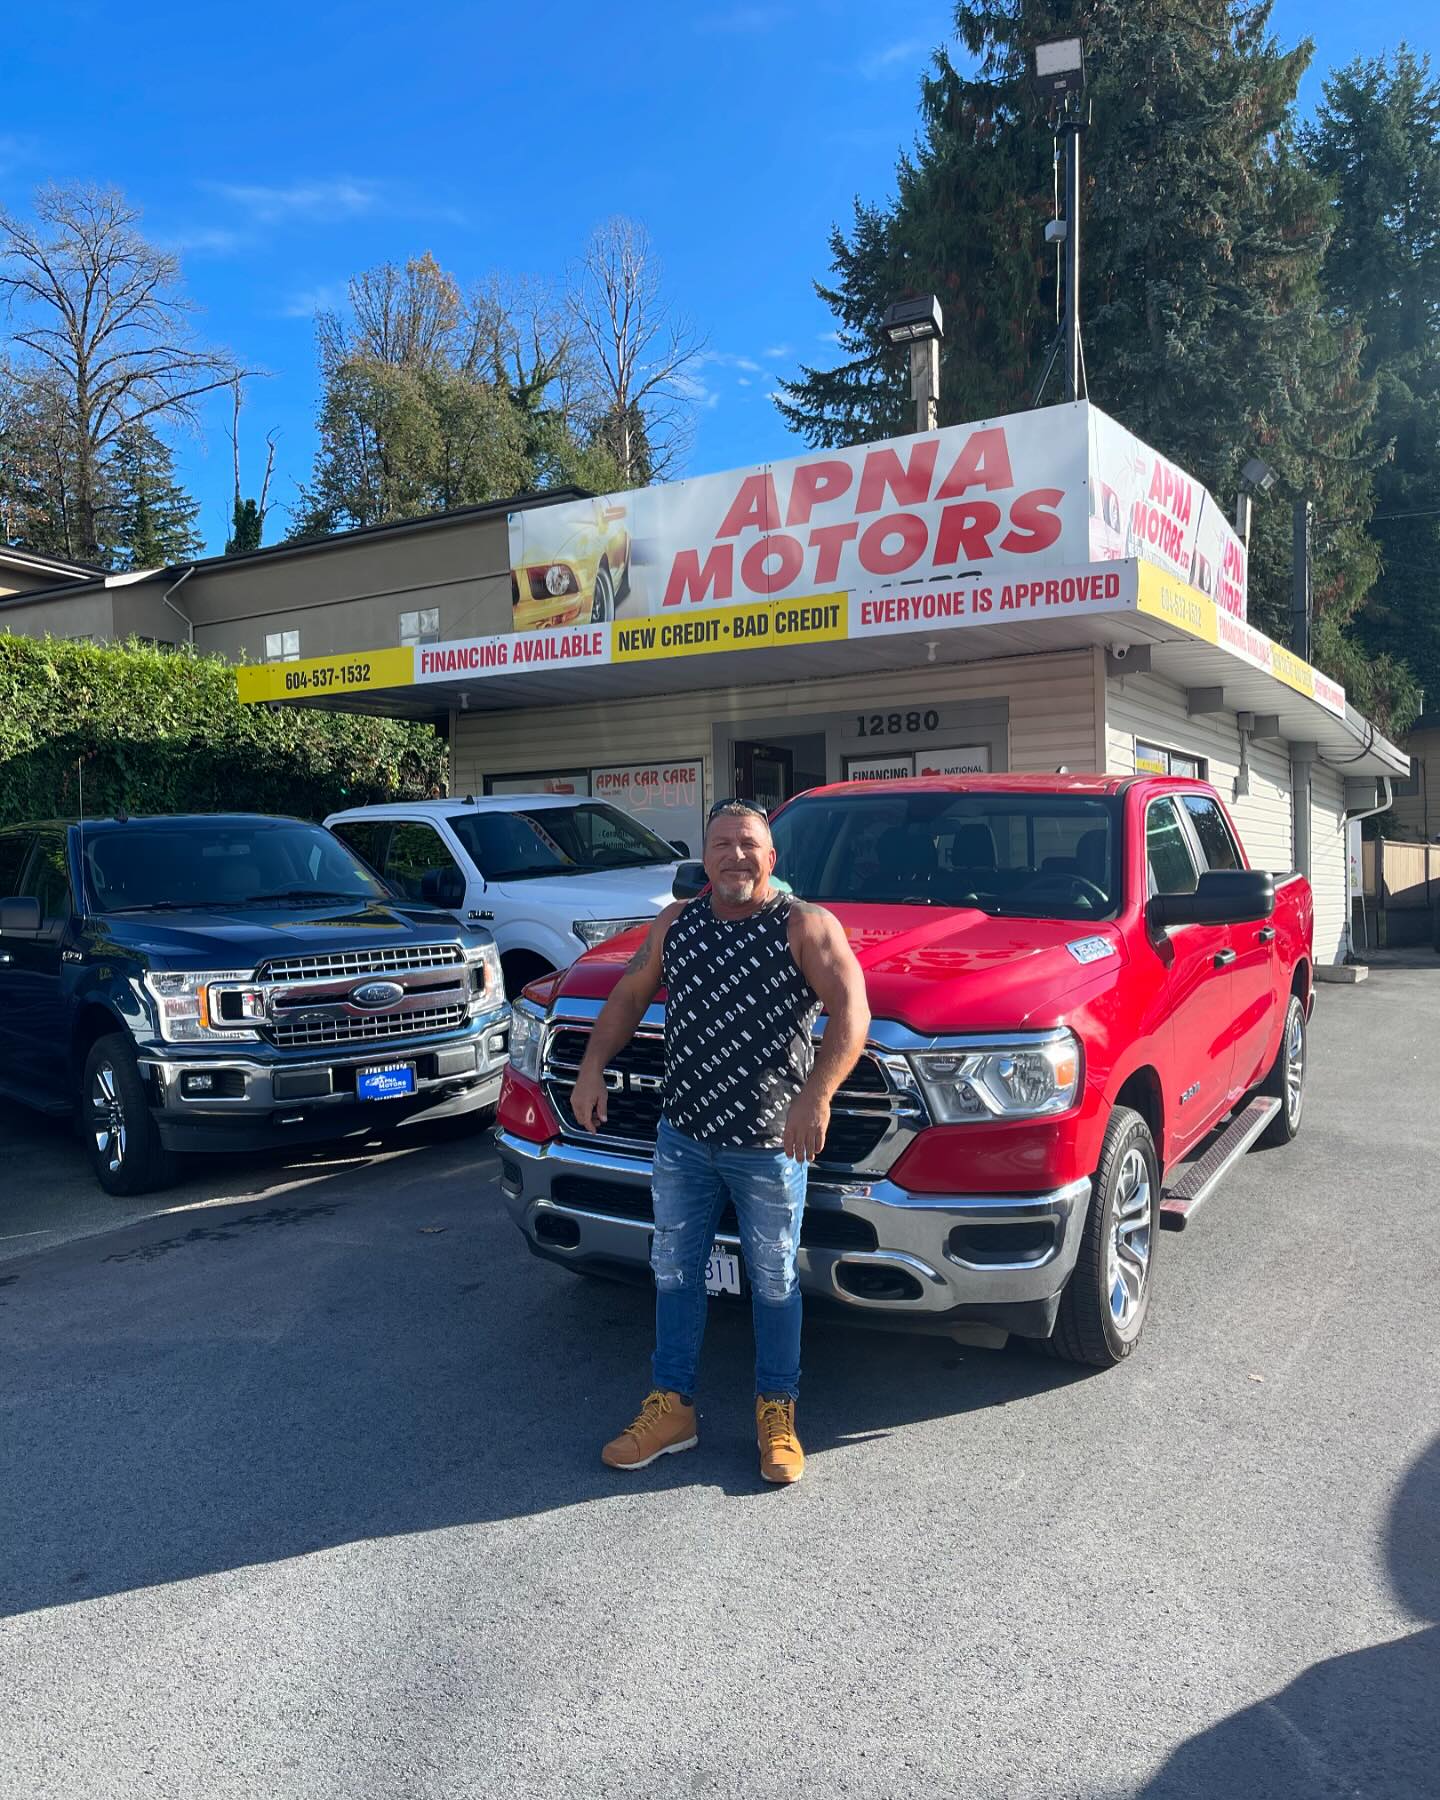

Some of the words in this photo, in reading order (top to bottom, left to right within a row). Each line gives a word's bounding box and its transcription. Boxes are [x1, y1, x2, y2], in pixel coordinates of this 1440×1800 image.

[715, 426, 1014, 540] APNA
[1149, 460, 1192, 527] APNA
[662, 488, 1066, 607] MOTORS
[1132, 501, 1184, 564] MOTORS
[861, 591, 965, 625] EVERYONE
[972, 588, 993, 613] IS
[1000, 573, 1120, 610] APPROVED
[618, 627, 656, 651] NEW
[661, 620, 721, 647] CREDIT
[733, 613, 769, 638] BAD
[775, 605, 840, 633] CREDIT
[421, 643, 508, 674] FINANCING
[513, 632, 603, 663] AVAILABLE
[285, 664, 371, 690] 604-537-1532
[857, 710, 940, 737] 12880
[596, 772, 630, 789] APNA
[634, 770, 659, 786] CAR
[663, 767, 696, 784] CARE
[853, 767, 908, 781] FINANCING
[944, 765, 983, 775] NATIONAL
[629, 780, 695, 807] OPEN
